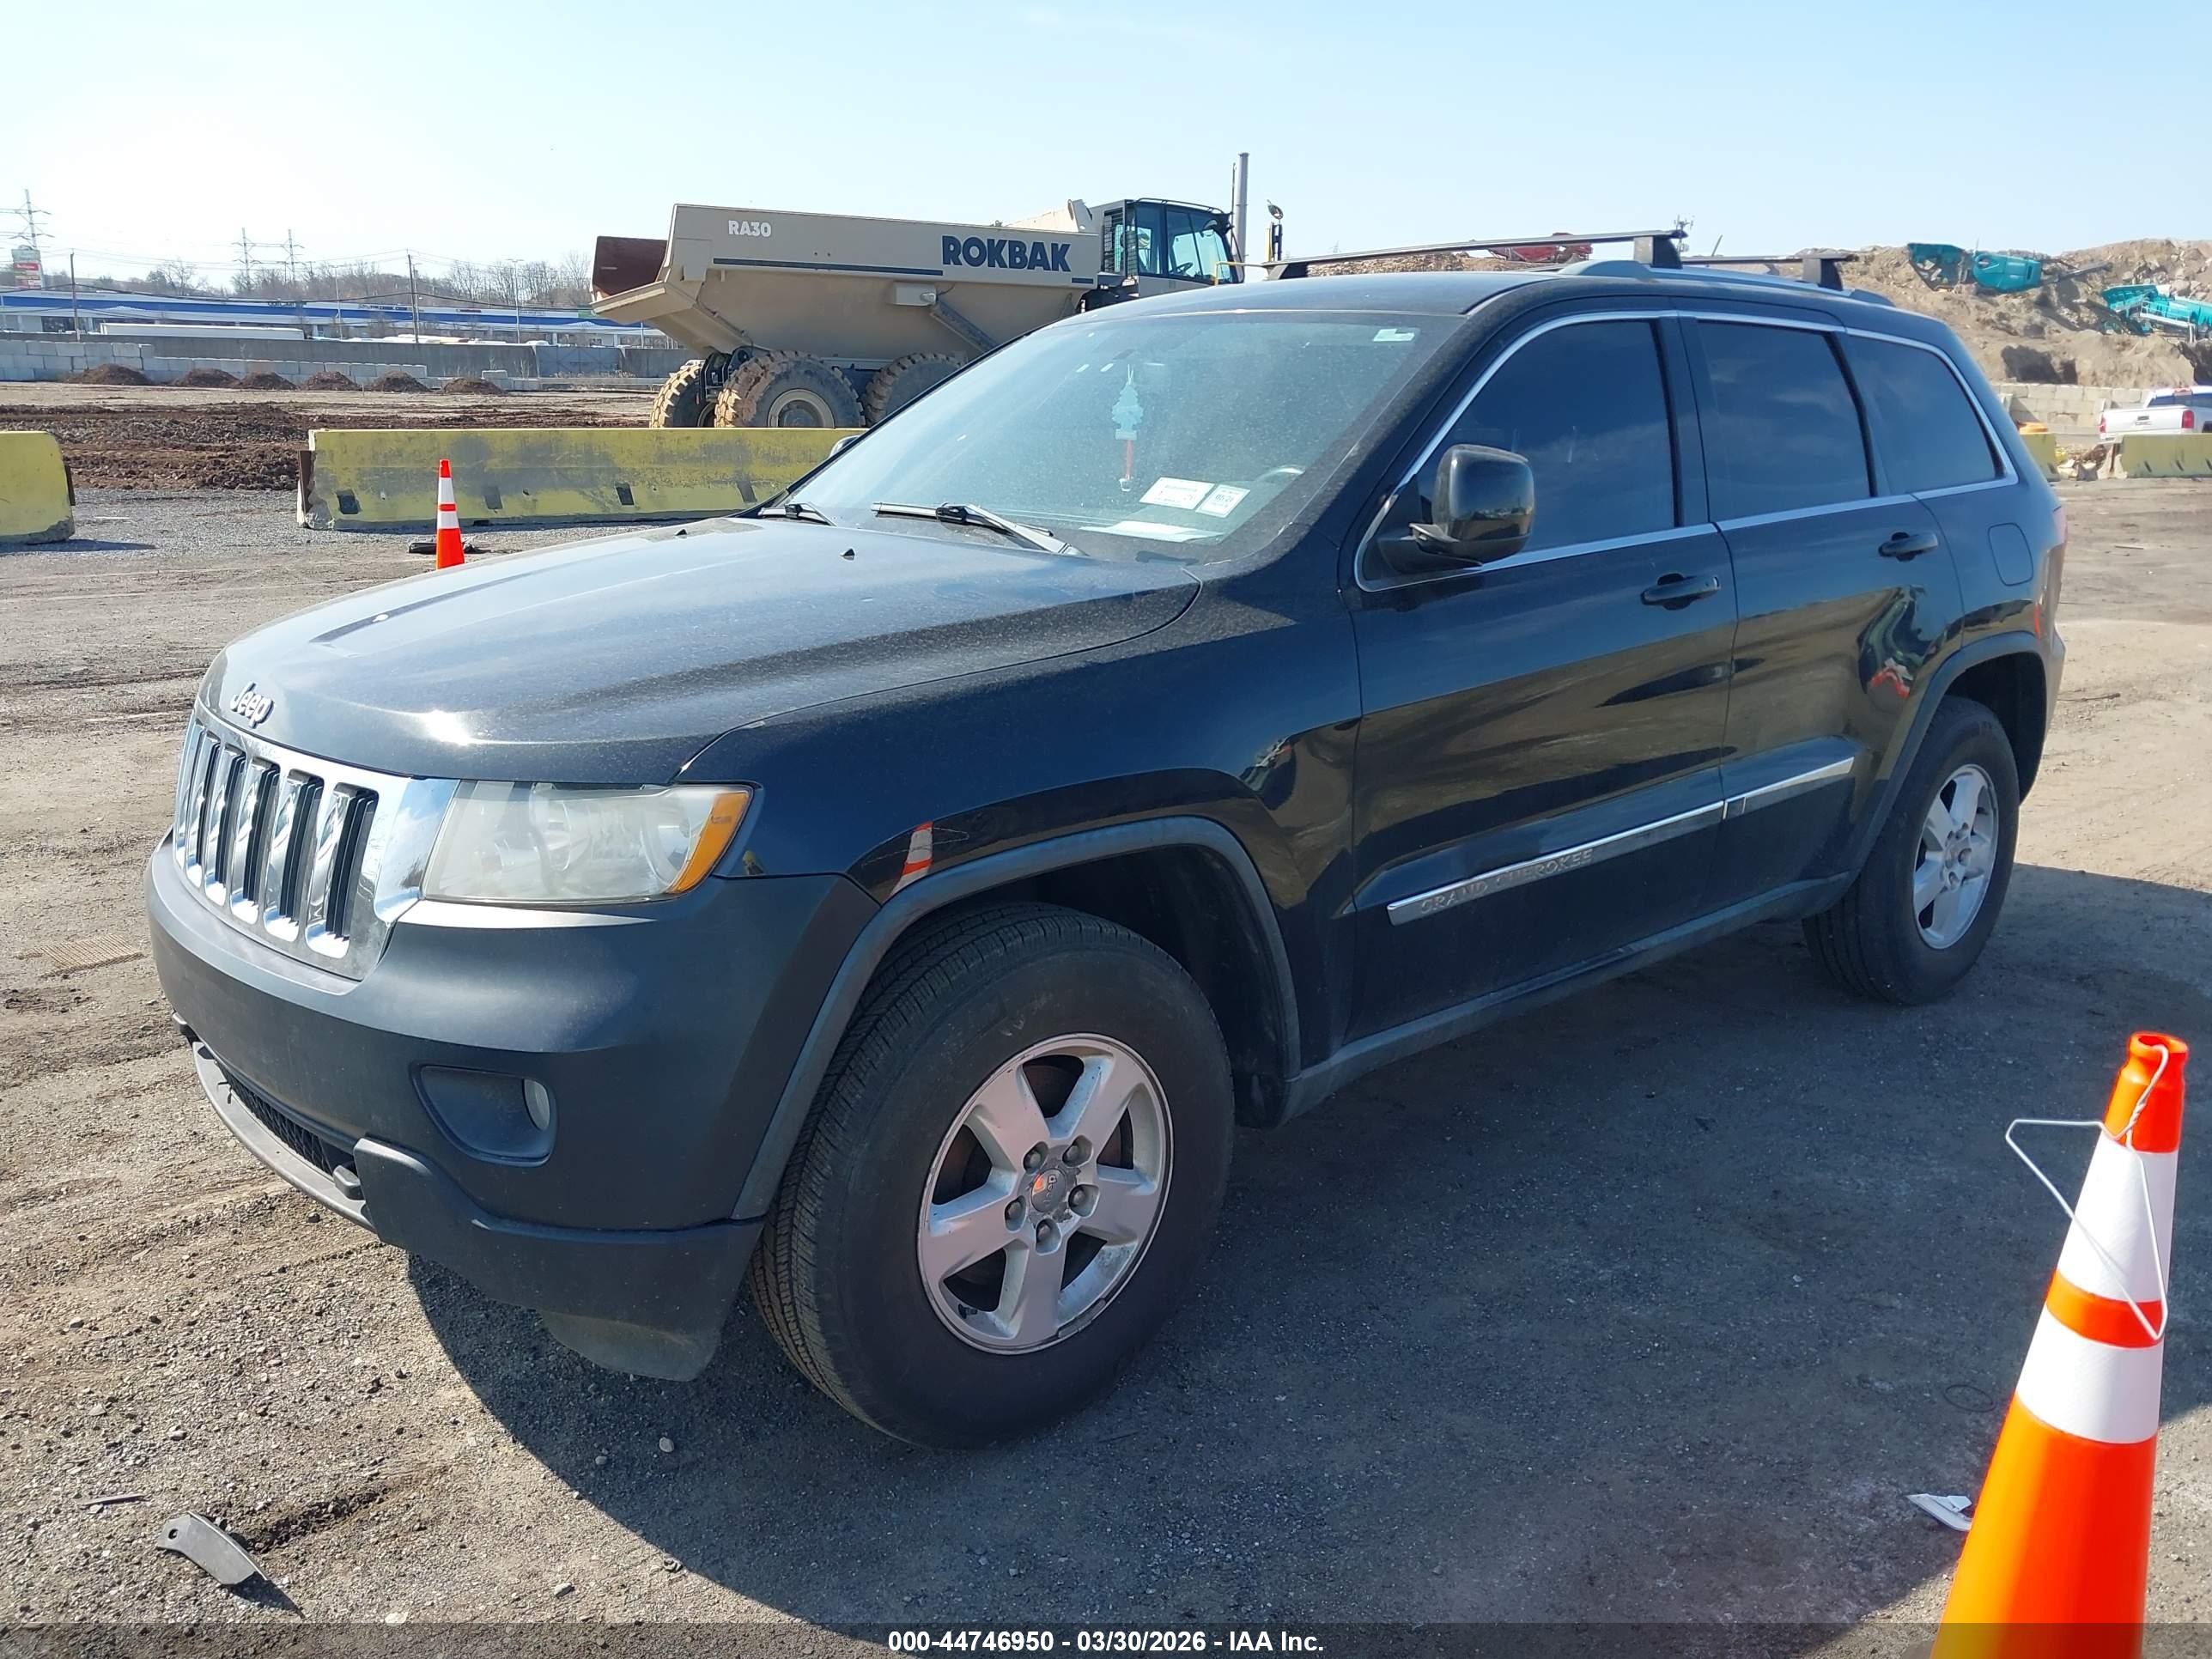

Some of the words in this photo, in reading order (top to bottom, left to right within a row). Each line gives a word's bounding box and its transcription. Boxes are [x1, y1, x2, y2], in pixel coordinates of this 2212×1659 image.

[728, 220, 771, 237] RA30
[942, 235, 1071, 272] ROKBAK
[230, 680, 274, 729] Jeep
[1421, 880, 1488, 915] GRAND
[1496, 848, 1594, 889] CHEROKEE
